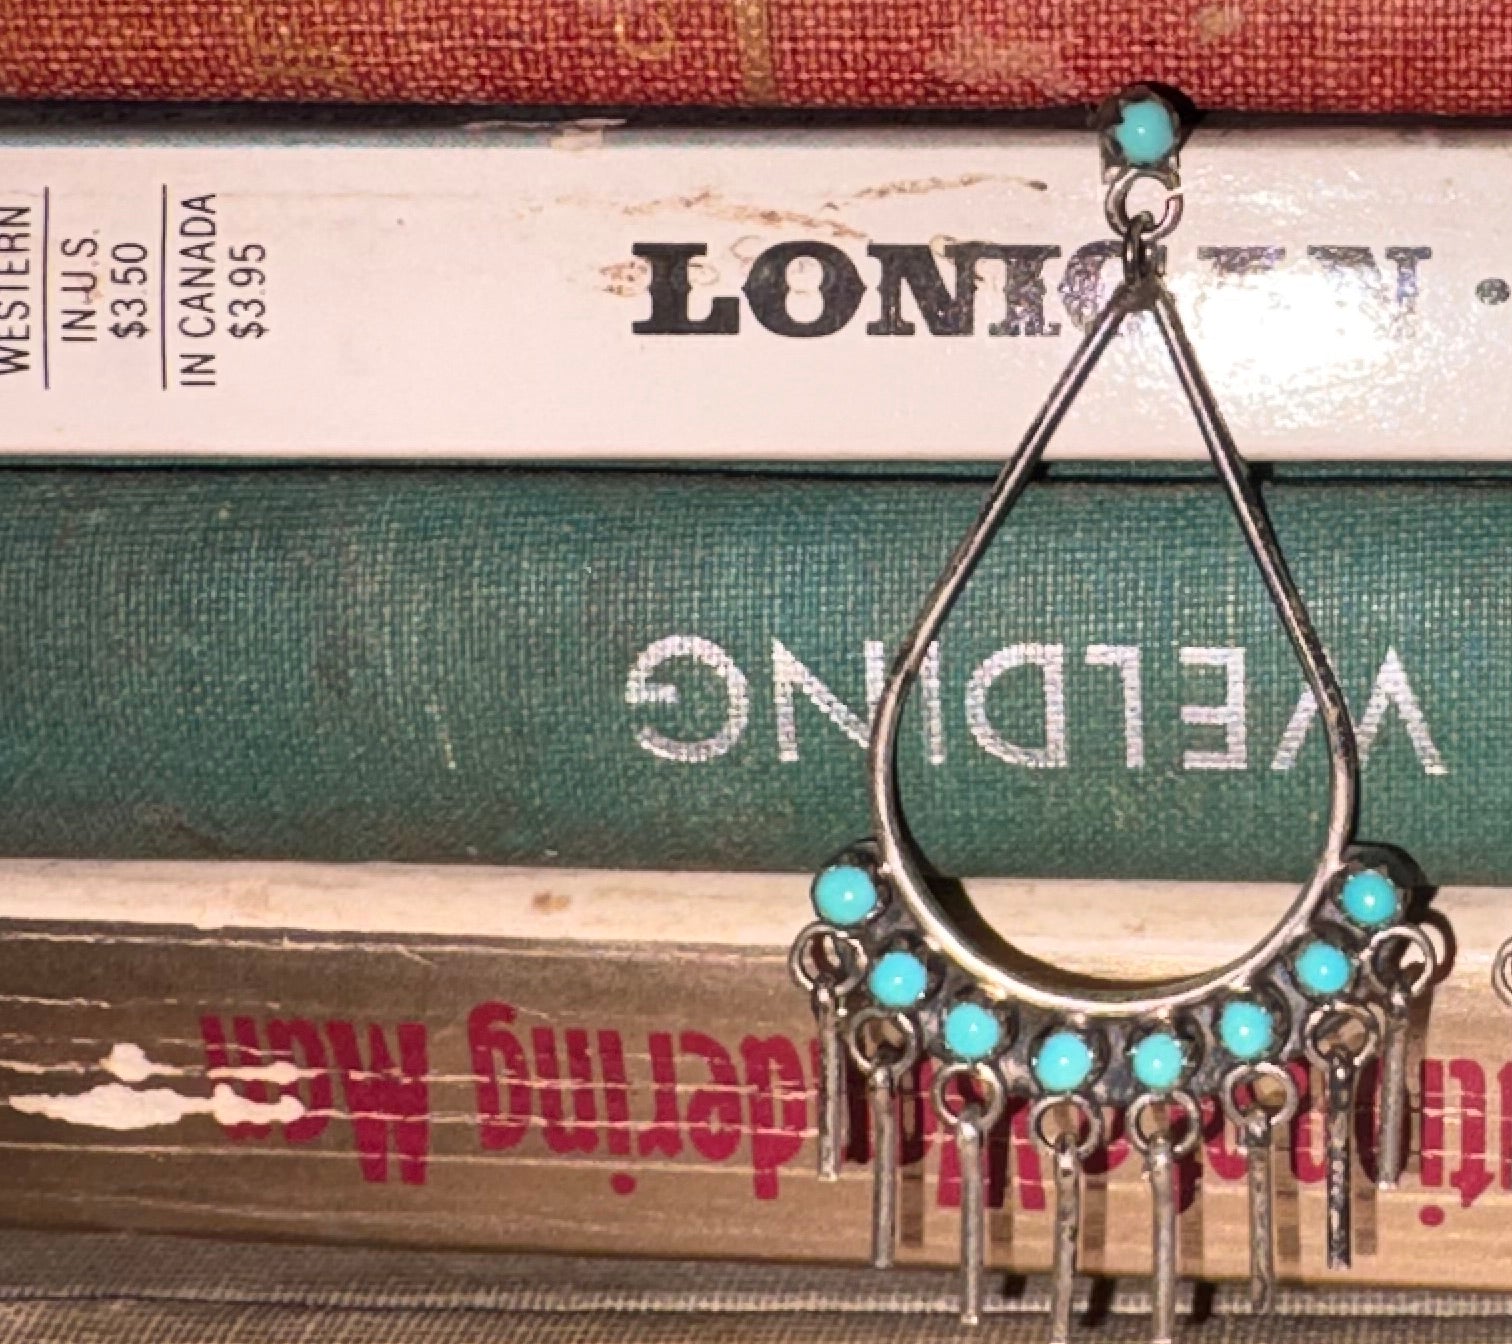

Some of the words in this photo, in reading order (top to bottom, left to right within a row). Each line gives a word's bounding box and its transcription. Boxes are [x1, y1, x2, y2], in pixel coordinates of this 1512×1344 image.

[60, 228, 101, 293] U.S.
[108, 242, 151, 340] $3.50
[178, 193, 217, 339] CANADA
[227, 243, 269, 340] $3.95
[60, 309, 98, 343] IN
[179, 353, 217, 387] IN
[625, 634, 1449, 776] WELDING
[200, 1015, 428, 1186] Man
